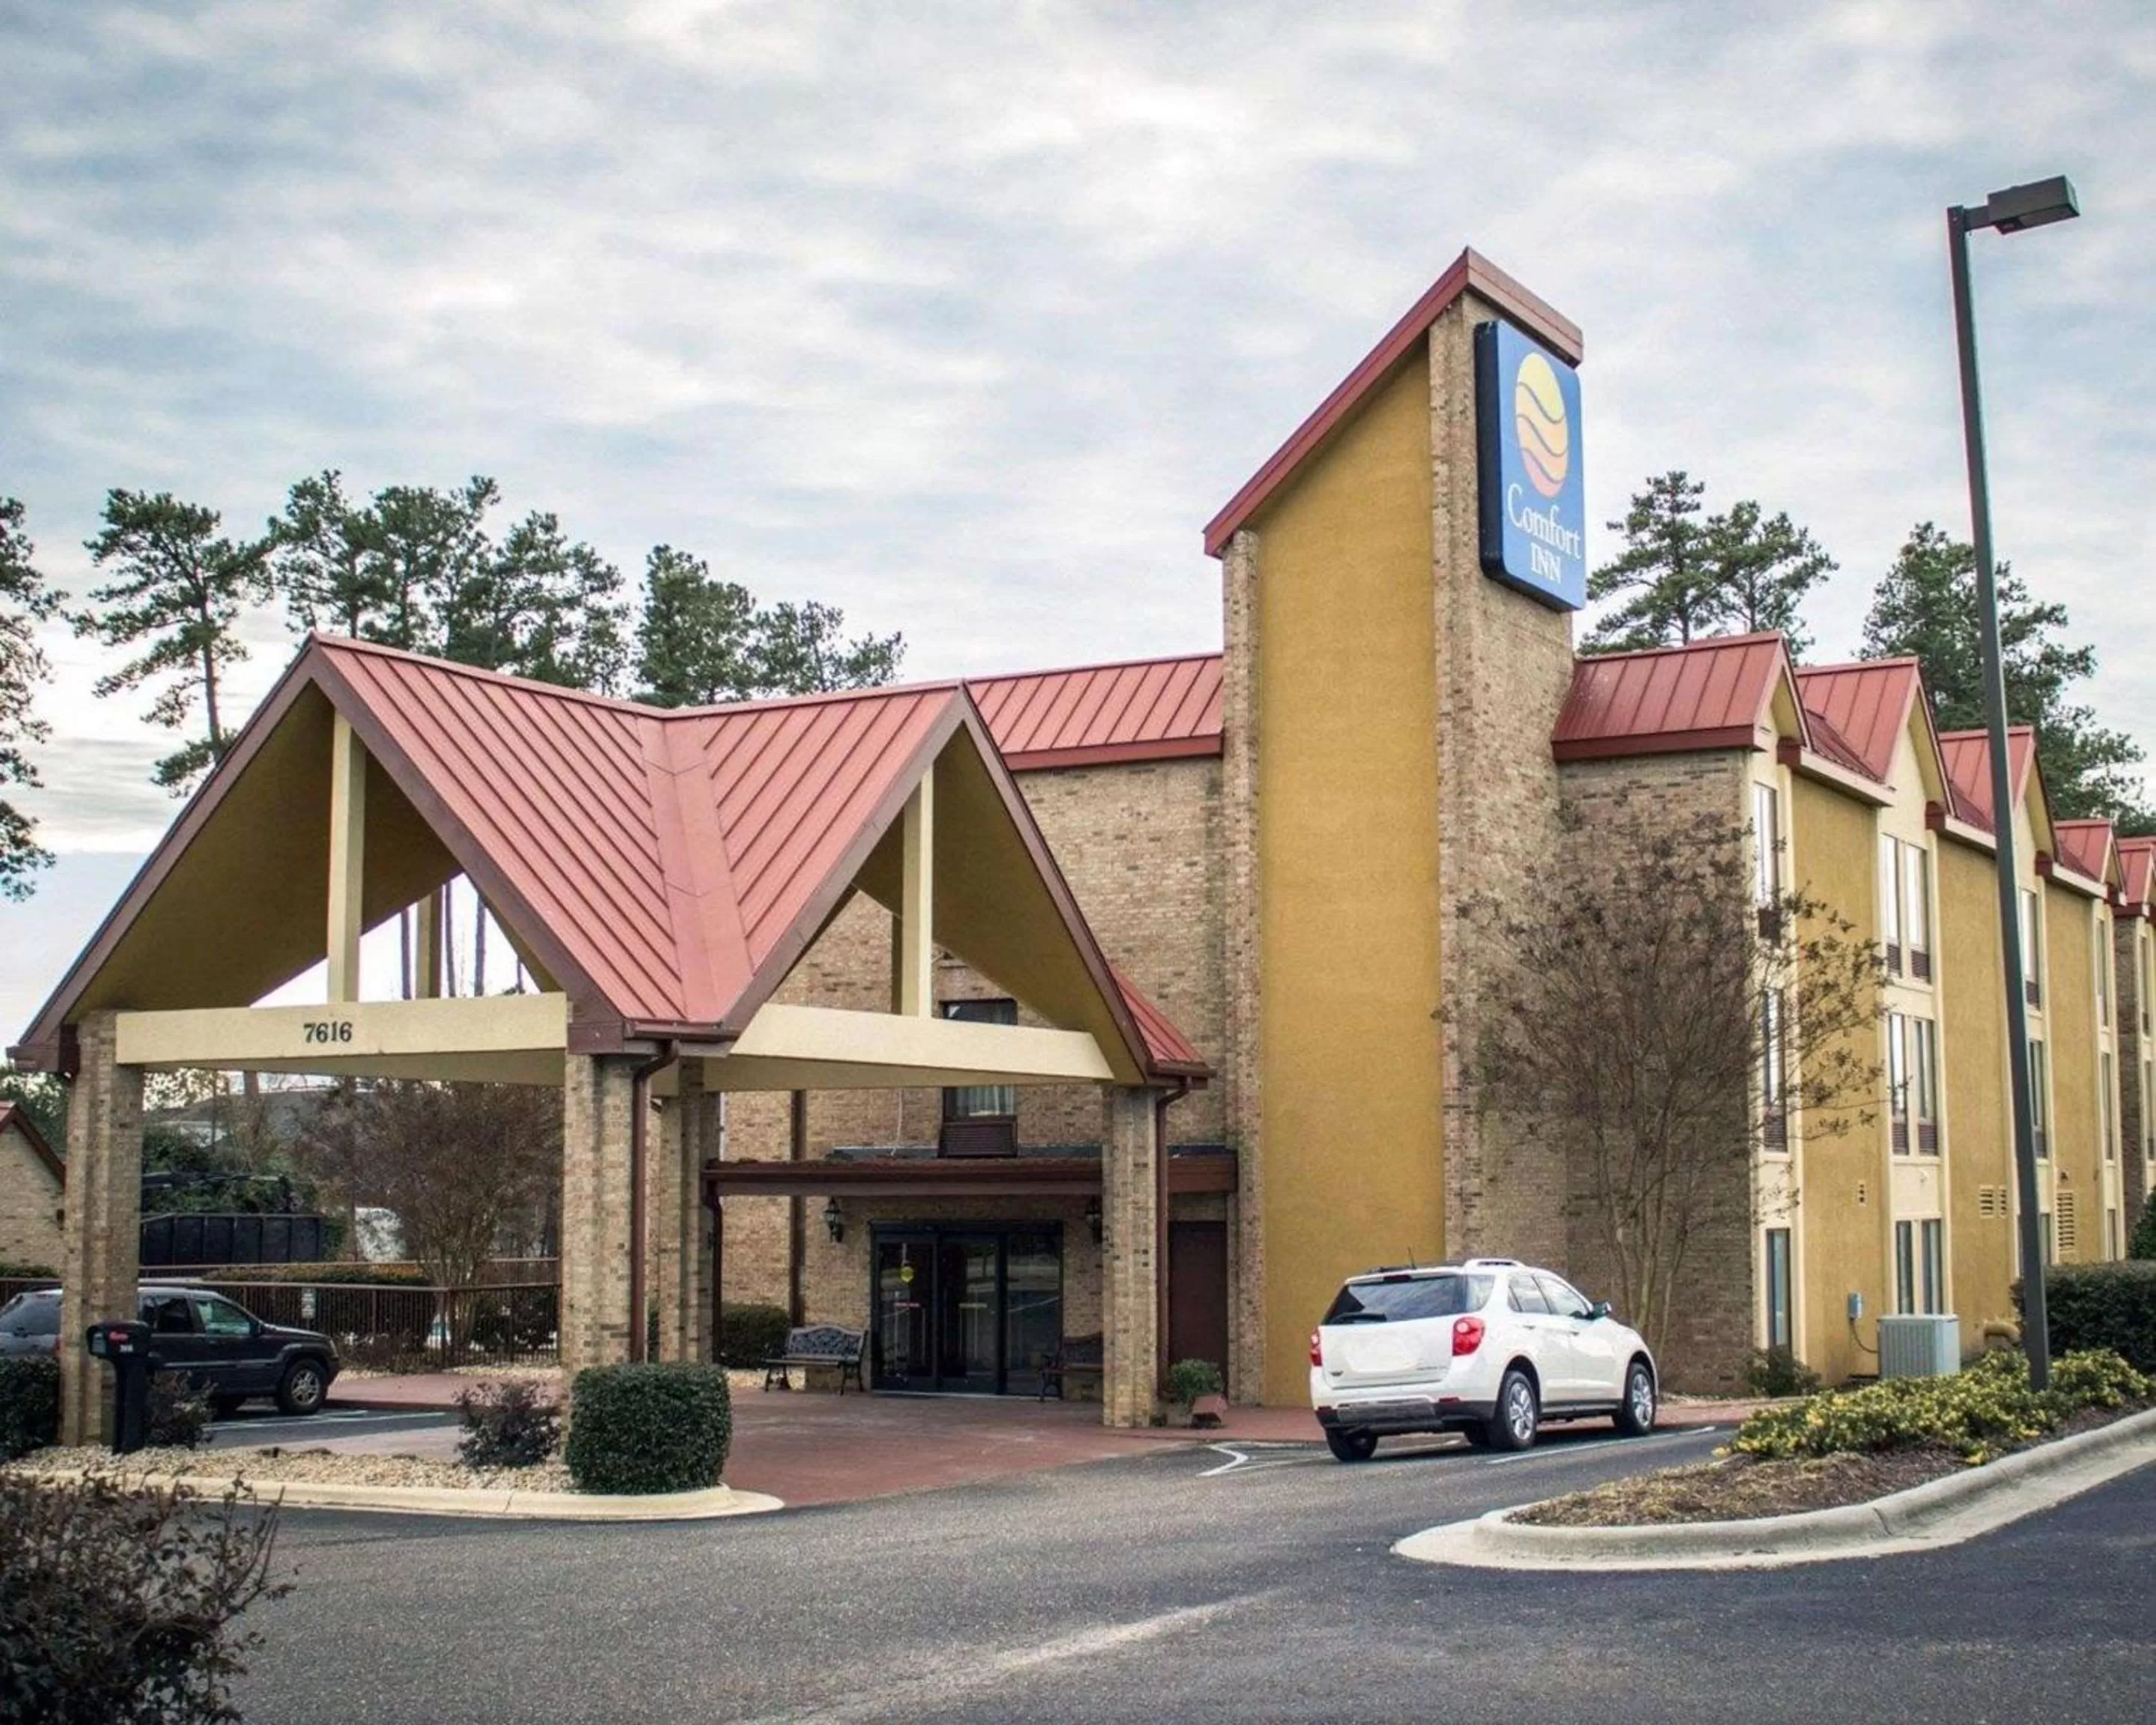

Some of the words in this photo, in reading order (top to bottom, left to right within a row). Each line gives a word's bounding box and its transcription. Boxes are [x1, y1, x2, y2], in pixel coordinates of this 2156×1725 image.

[1507, 482, 1582, 560] Comfort
[1529, 541, 1562, 584] INN
[302, 1020, 353, 1044] 7616
